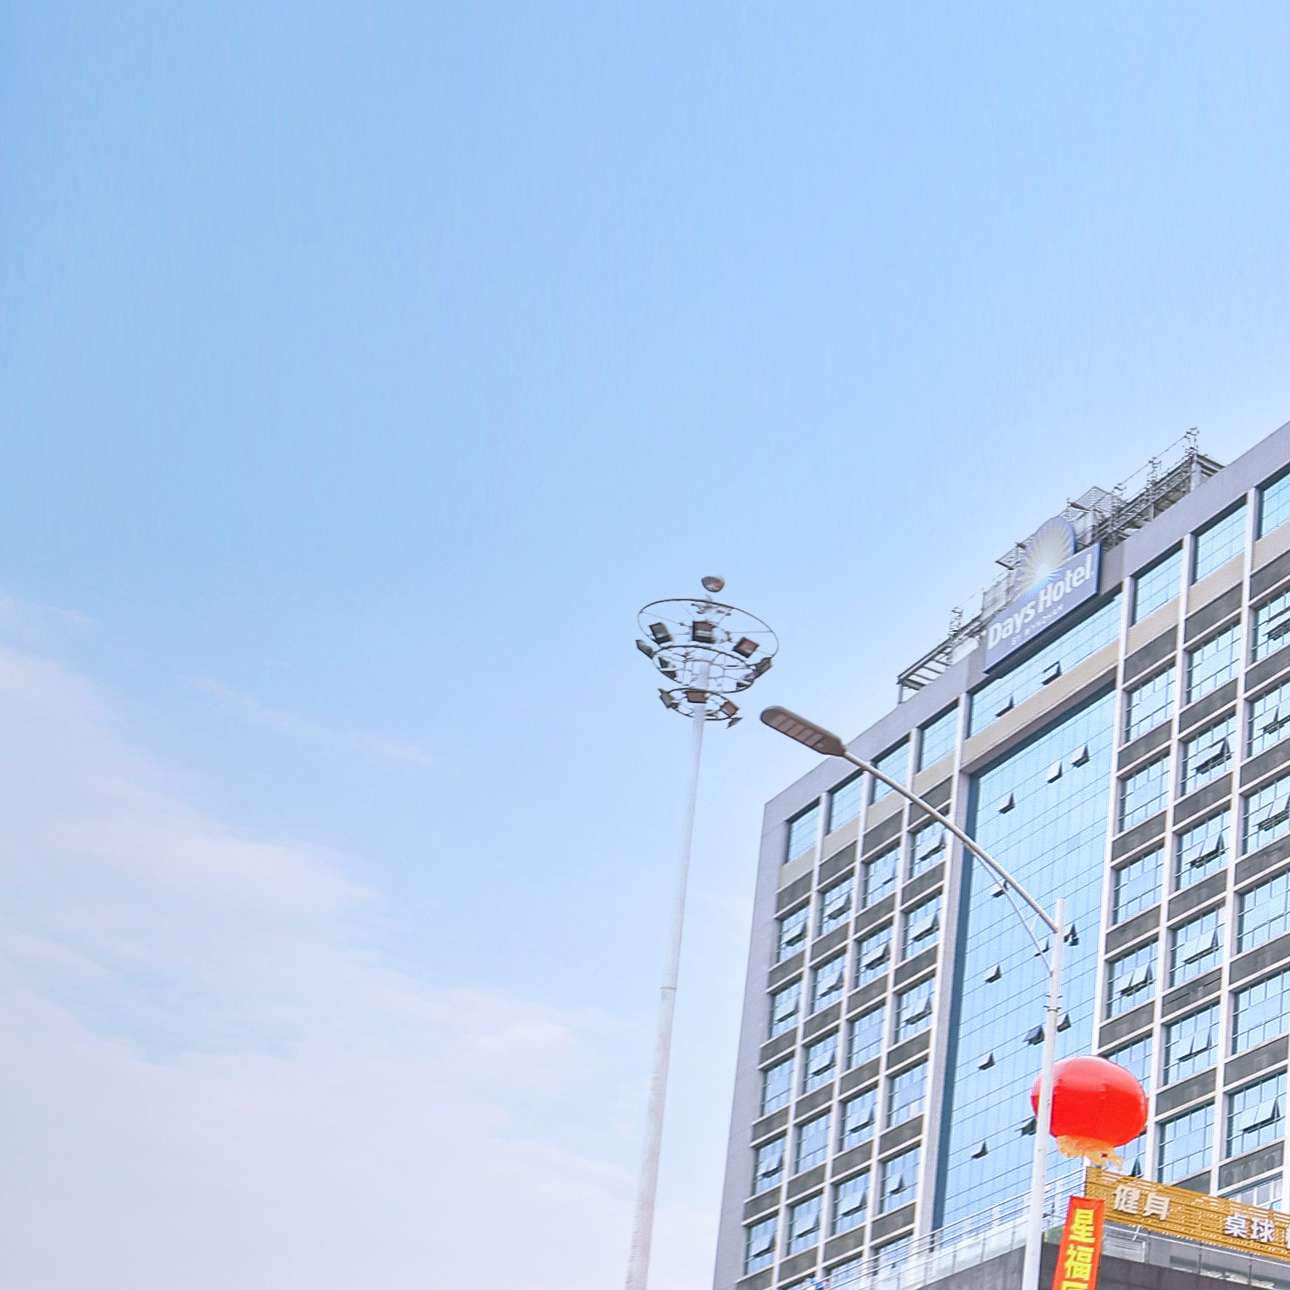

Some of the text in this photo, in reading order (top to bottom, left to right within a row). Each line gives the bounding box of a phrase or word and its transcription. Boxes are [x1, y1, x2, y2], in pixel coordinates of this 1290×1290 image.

[987, 600, 1036, 650] Days
[1037, 553, 1092, 614] Hotel
[1224, 1212, 1275, 1244] 桌球
